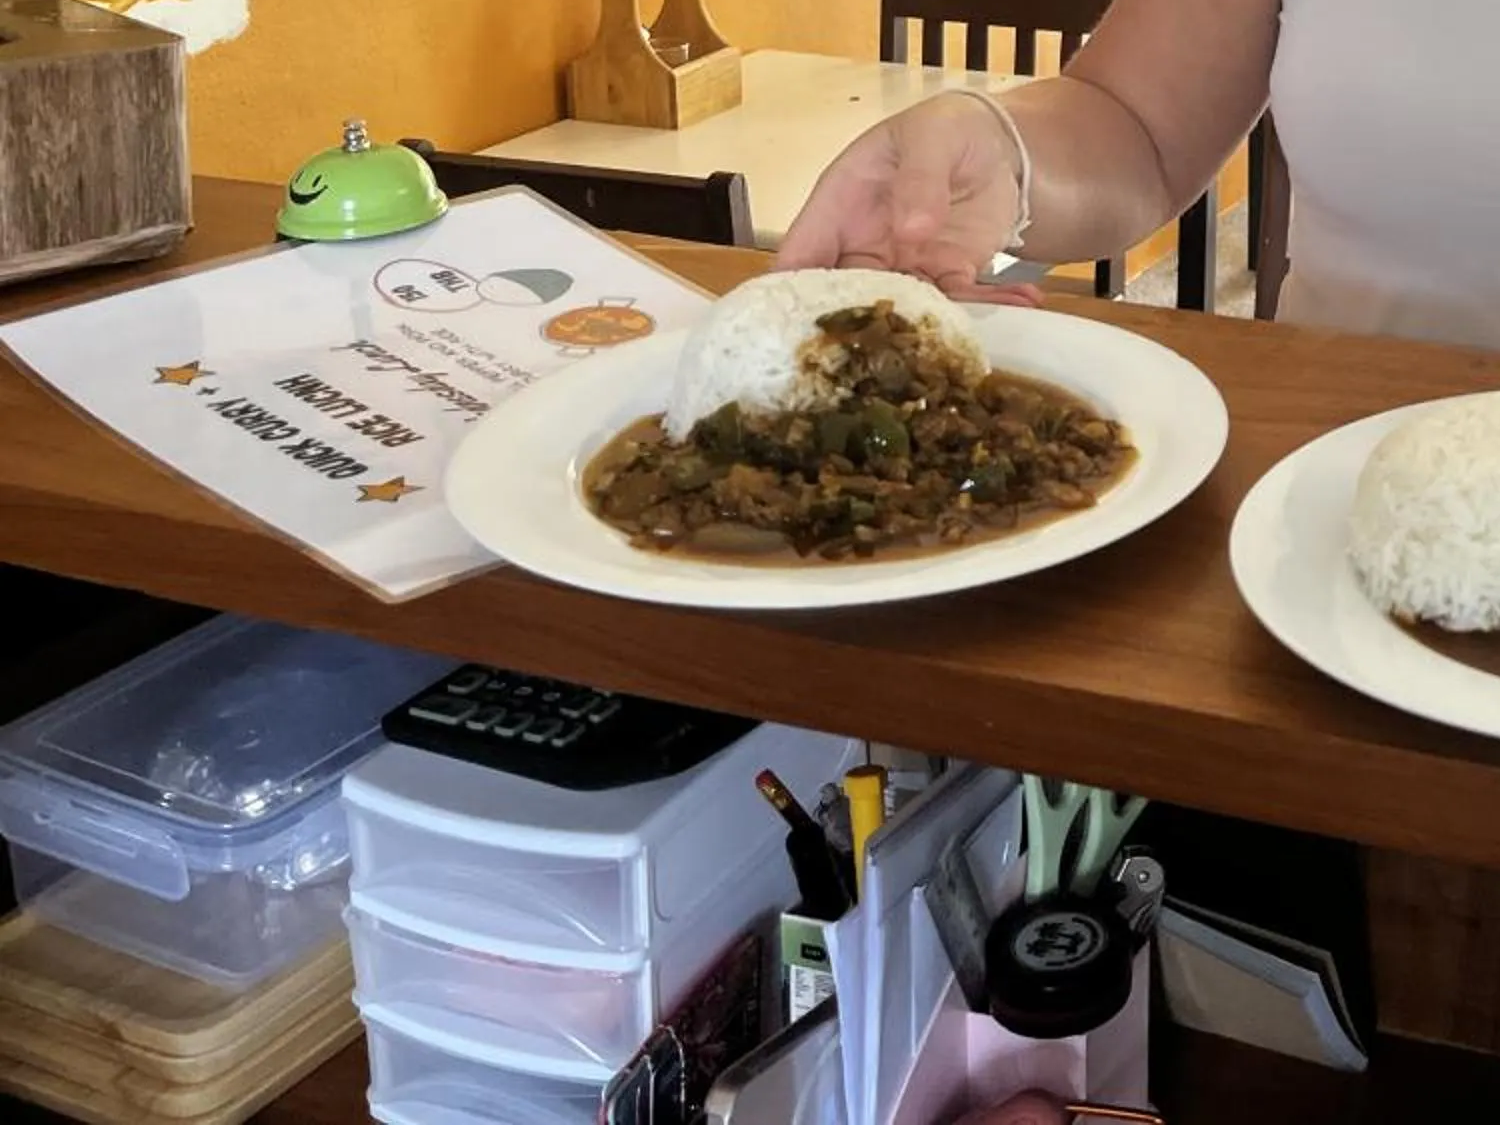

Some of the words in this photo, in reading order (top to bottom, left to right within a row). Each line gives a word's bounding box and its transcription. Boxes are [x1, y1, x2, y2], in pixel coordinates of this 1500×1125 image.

[429, 270, 471, 293] THB
[329, 340, 422, 373] Lunch
[206, 397, 300, 441] CURRY
[345, 414, 425, 447] RICE
[277, 438, 369, 480] QUICK
